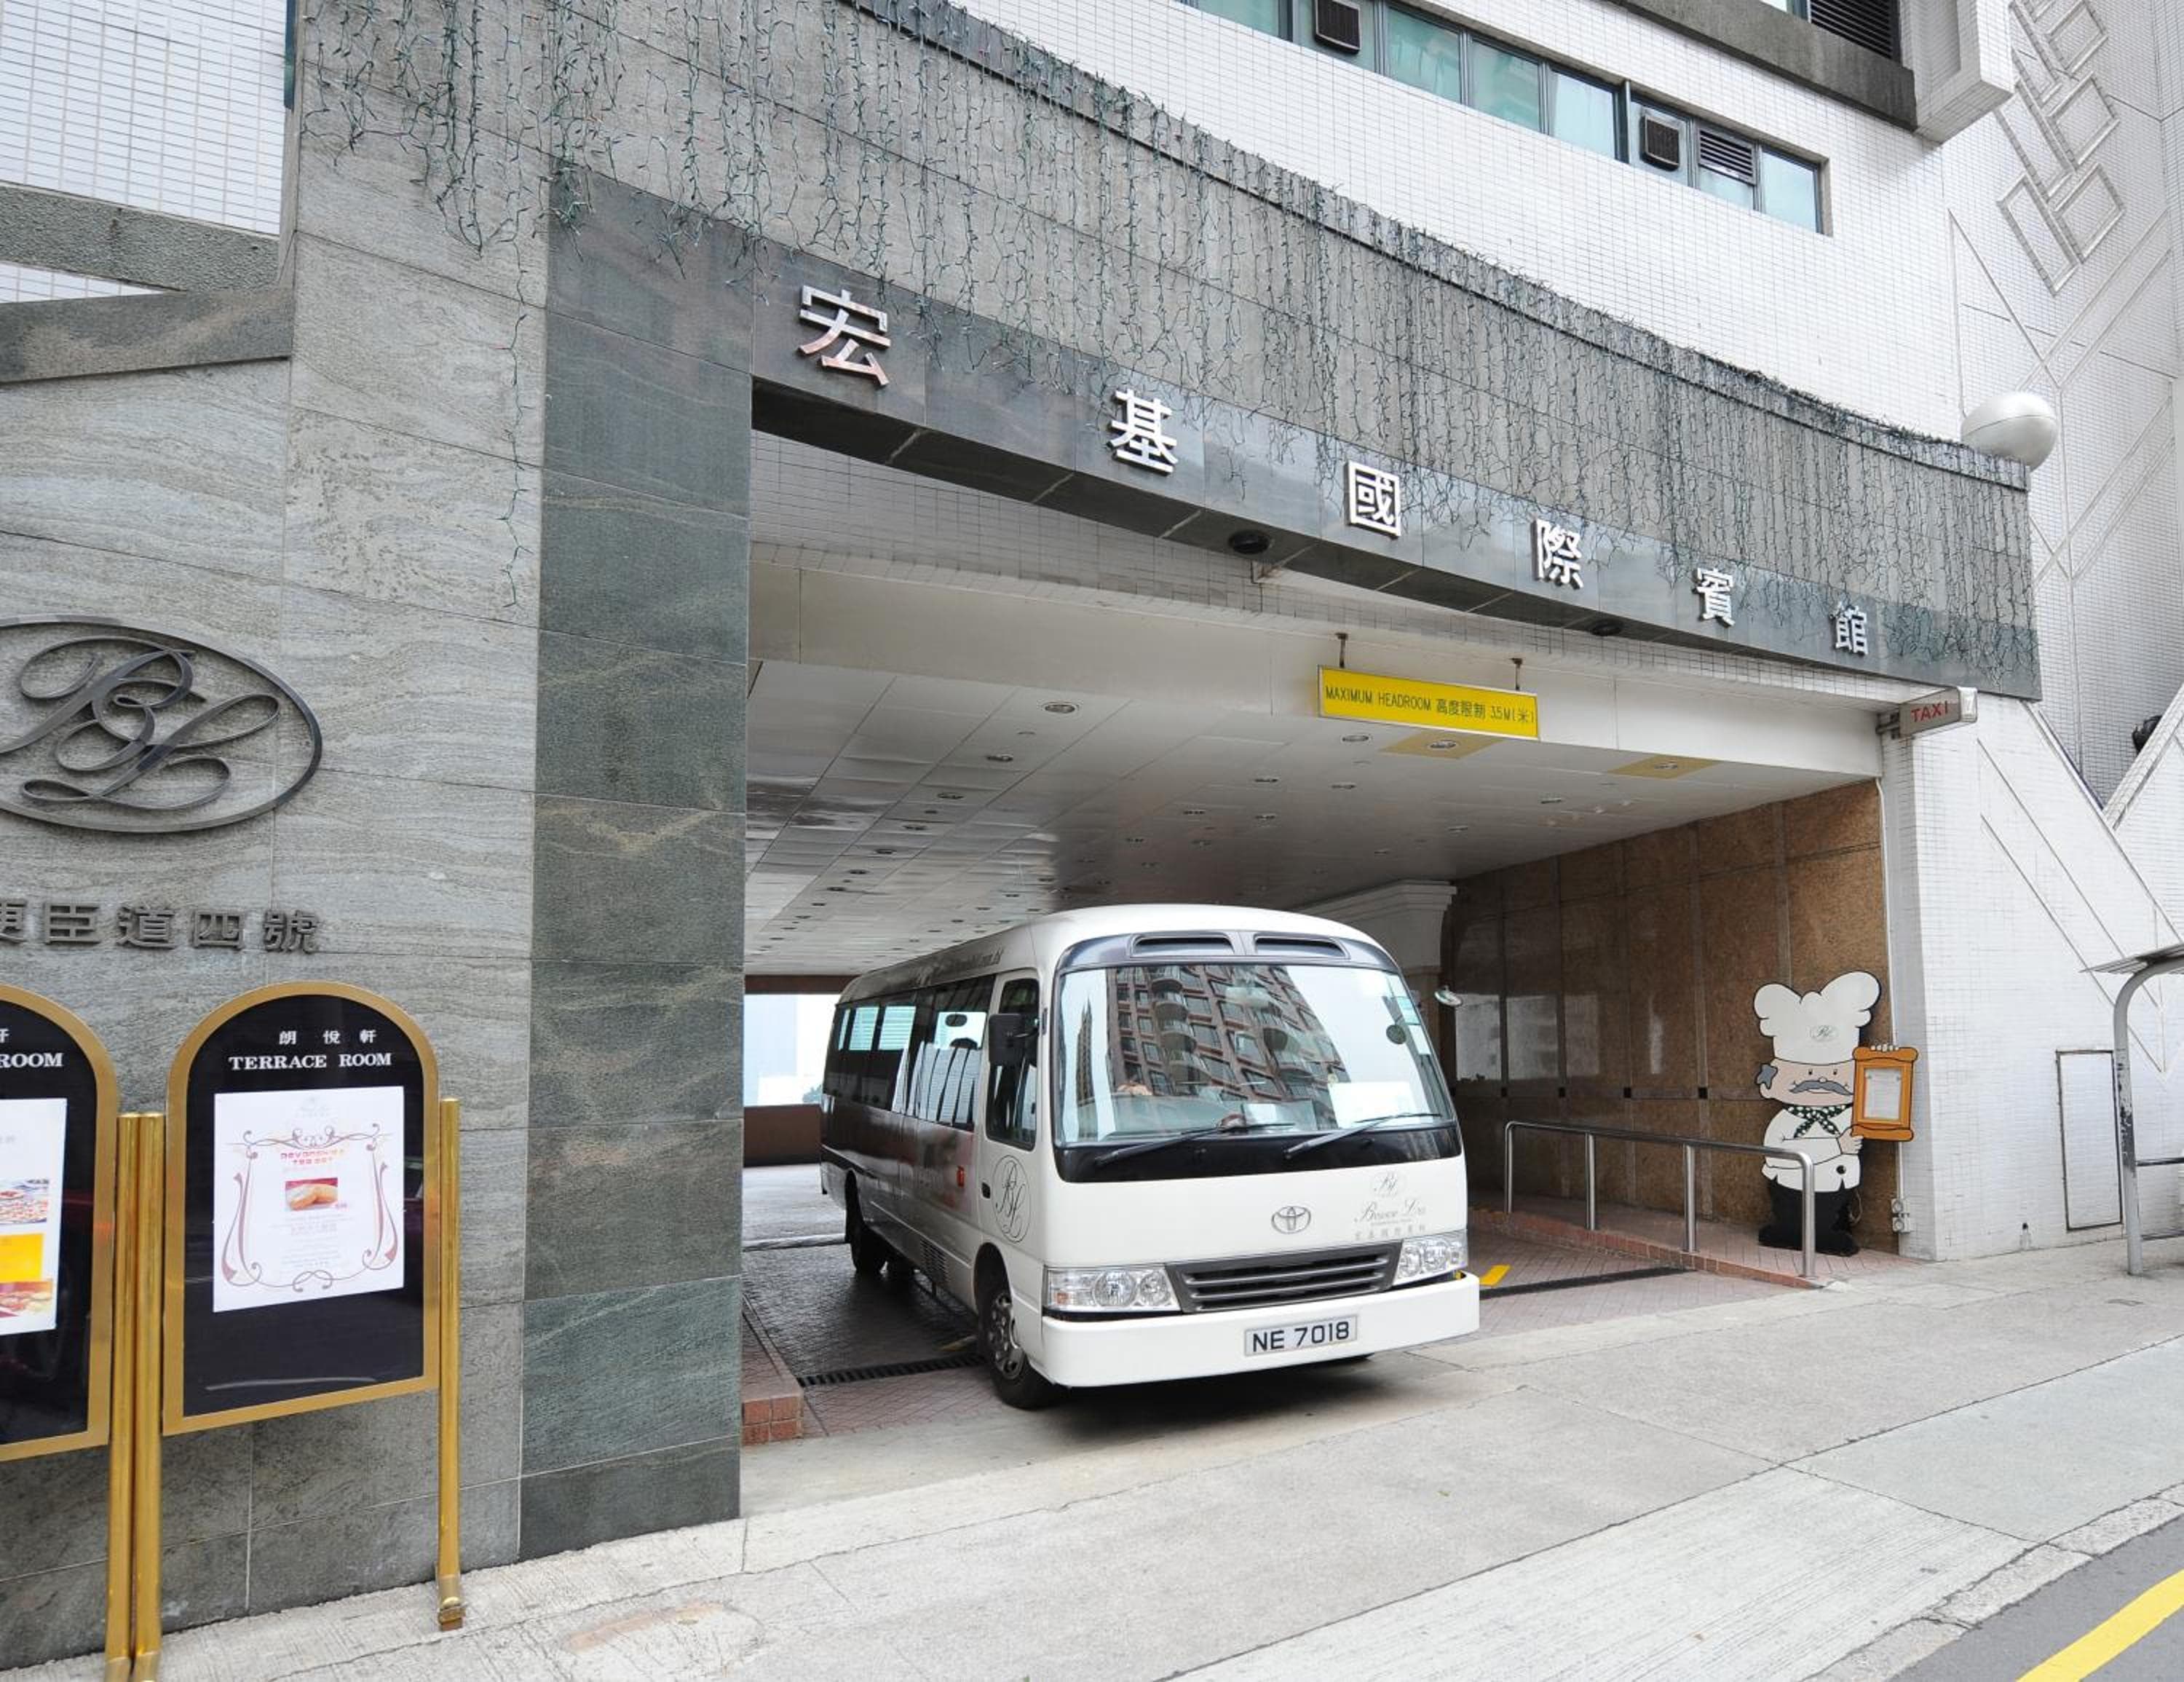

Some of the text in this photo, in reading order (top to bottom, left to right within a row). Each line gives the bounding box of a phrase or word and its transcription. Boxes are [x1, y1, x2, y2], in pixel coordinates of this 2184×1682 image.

[799, 285, 1869, 655] 宏基國際賓館
[1326, 685, 1372, 704] MAXIMUM
[1379, 692, 1431, 711] HEADROOM
[1437, 698, 1485, 719] 高度限制
[1911, 700, 1948, 722] TAXI
[0, 1052, 63, 1068] ROOM
[228, 1053, 392, 1070] TERRACE ROOM
[1253, 1322, 1349, 1351] NE 7018
